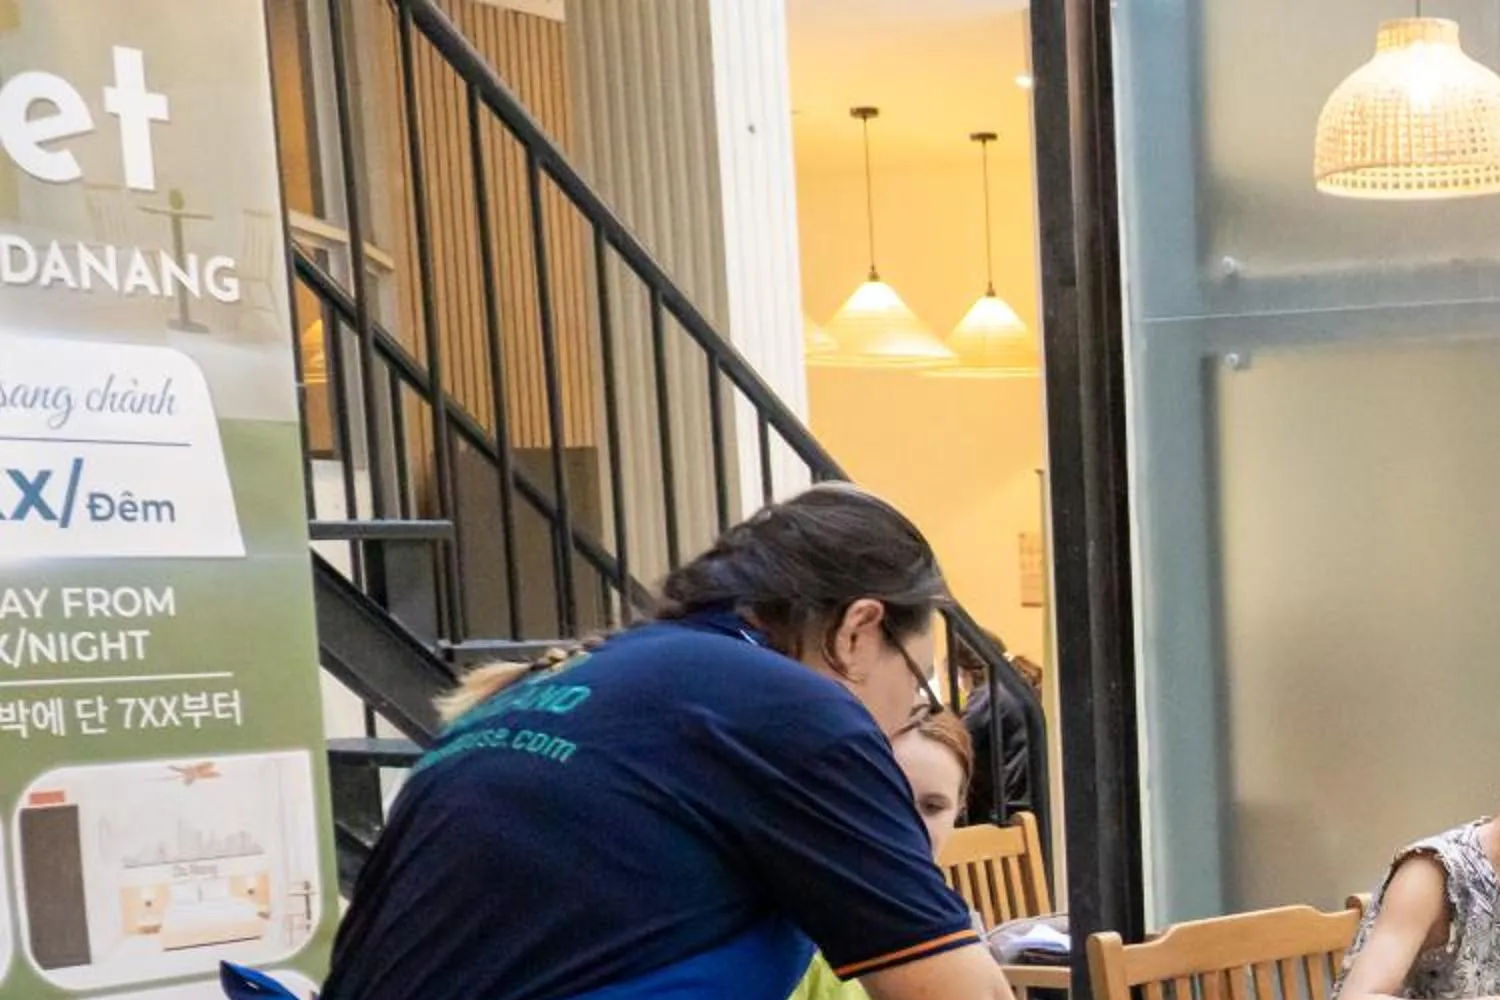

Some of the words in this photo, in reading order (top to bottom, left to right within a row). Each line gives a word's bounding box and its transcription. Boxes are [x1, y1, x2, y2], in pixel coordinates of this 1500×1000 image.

[0, 45, 170, 190] et
[1, 234, 241, 302] DANANG
[0, 587, 48, 619] AY
[61, 586, 176, 619] FROM
[75, 694, 109, 735] 단
